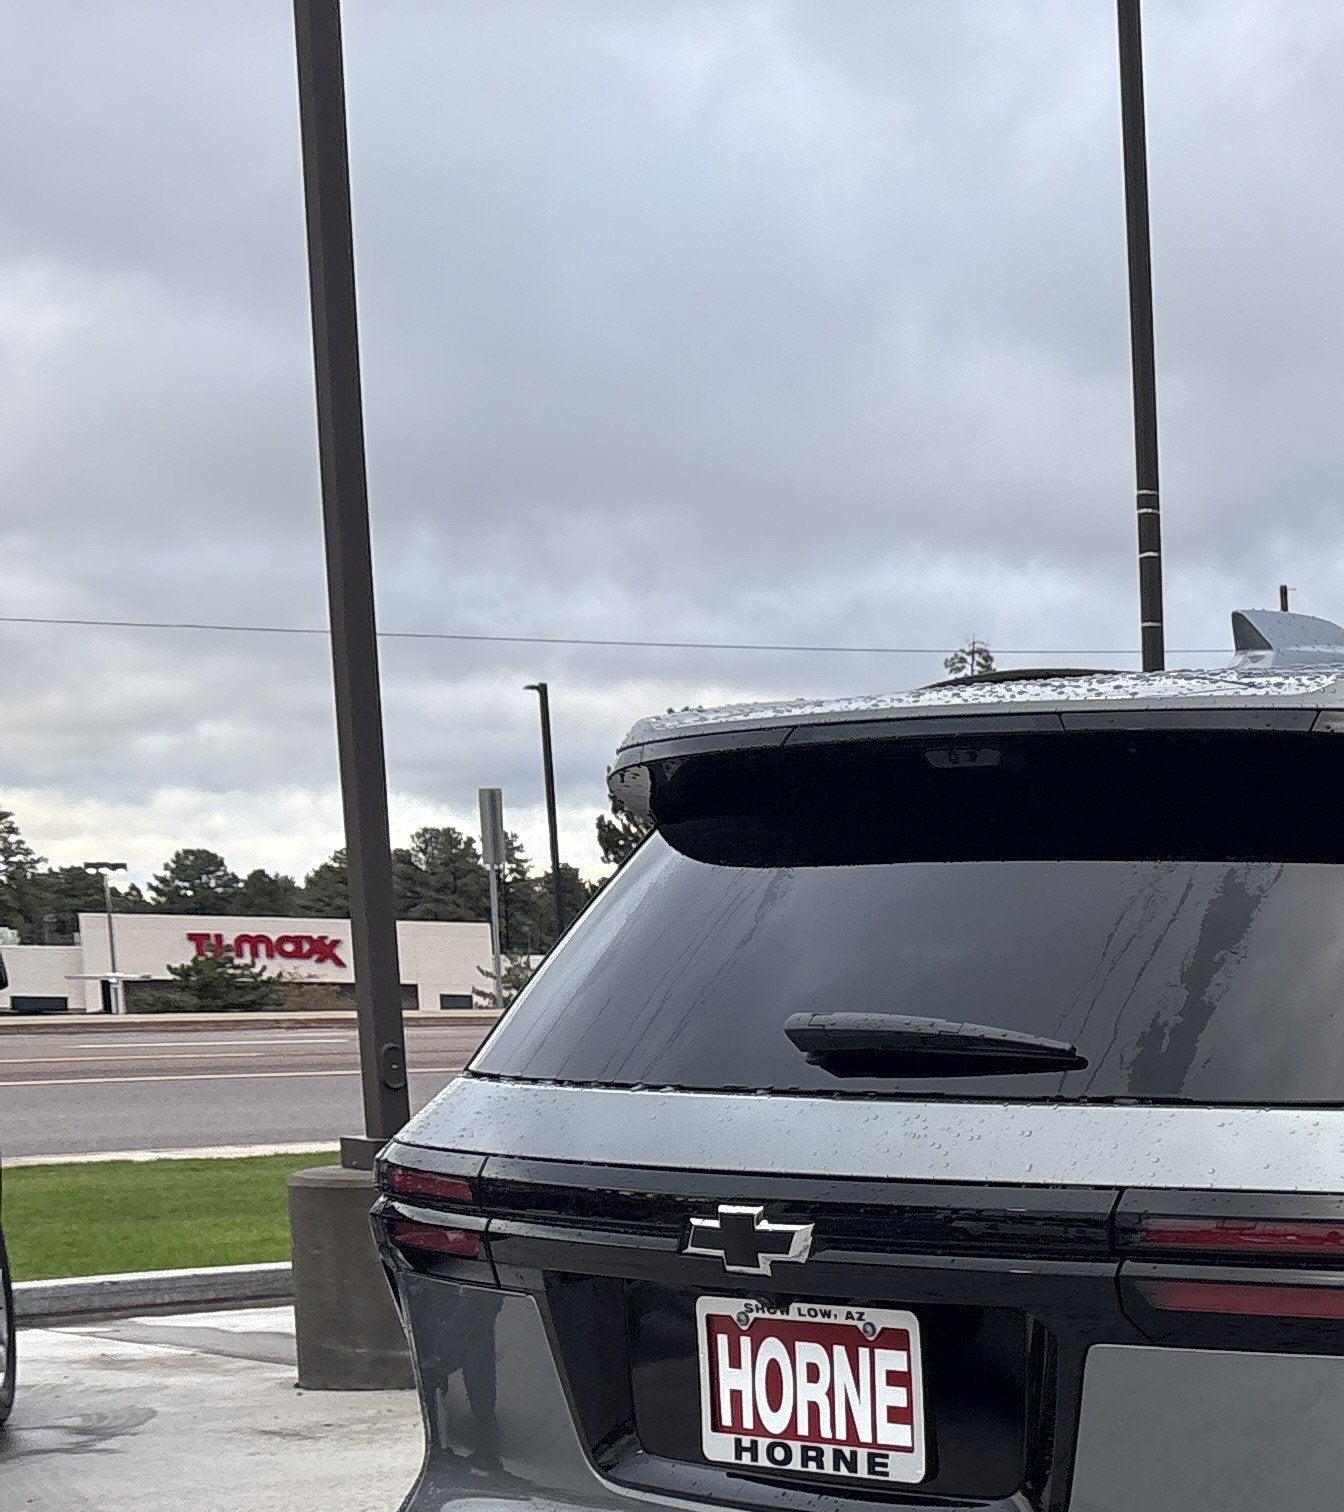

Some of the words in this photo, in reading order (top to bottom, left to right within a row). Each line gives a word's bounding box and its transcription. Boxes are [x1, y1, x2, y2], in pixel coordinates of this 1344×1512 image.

[797, 1307, 838, 1321] LOW,
[845, 1311, 867, 1322] AZ
[717, 1334, 912, 1448] HORNE
[734, 1437, 890, 1478] HORNE
